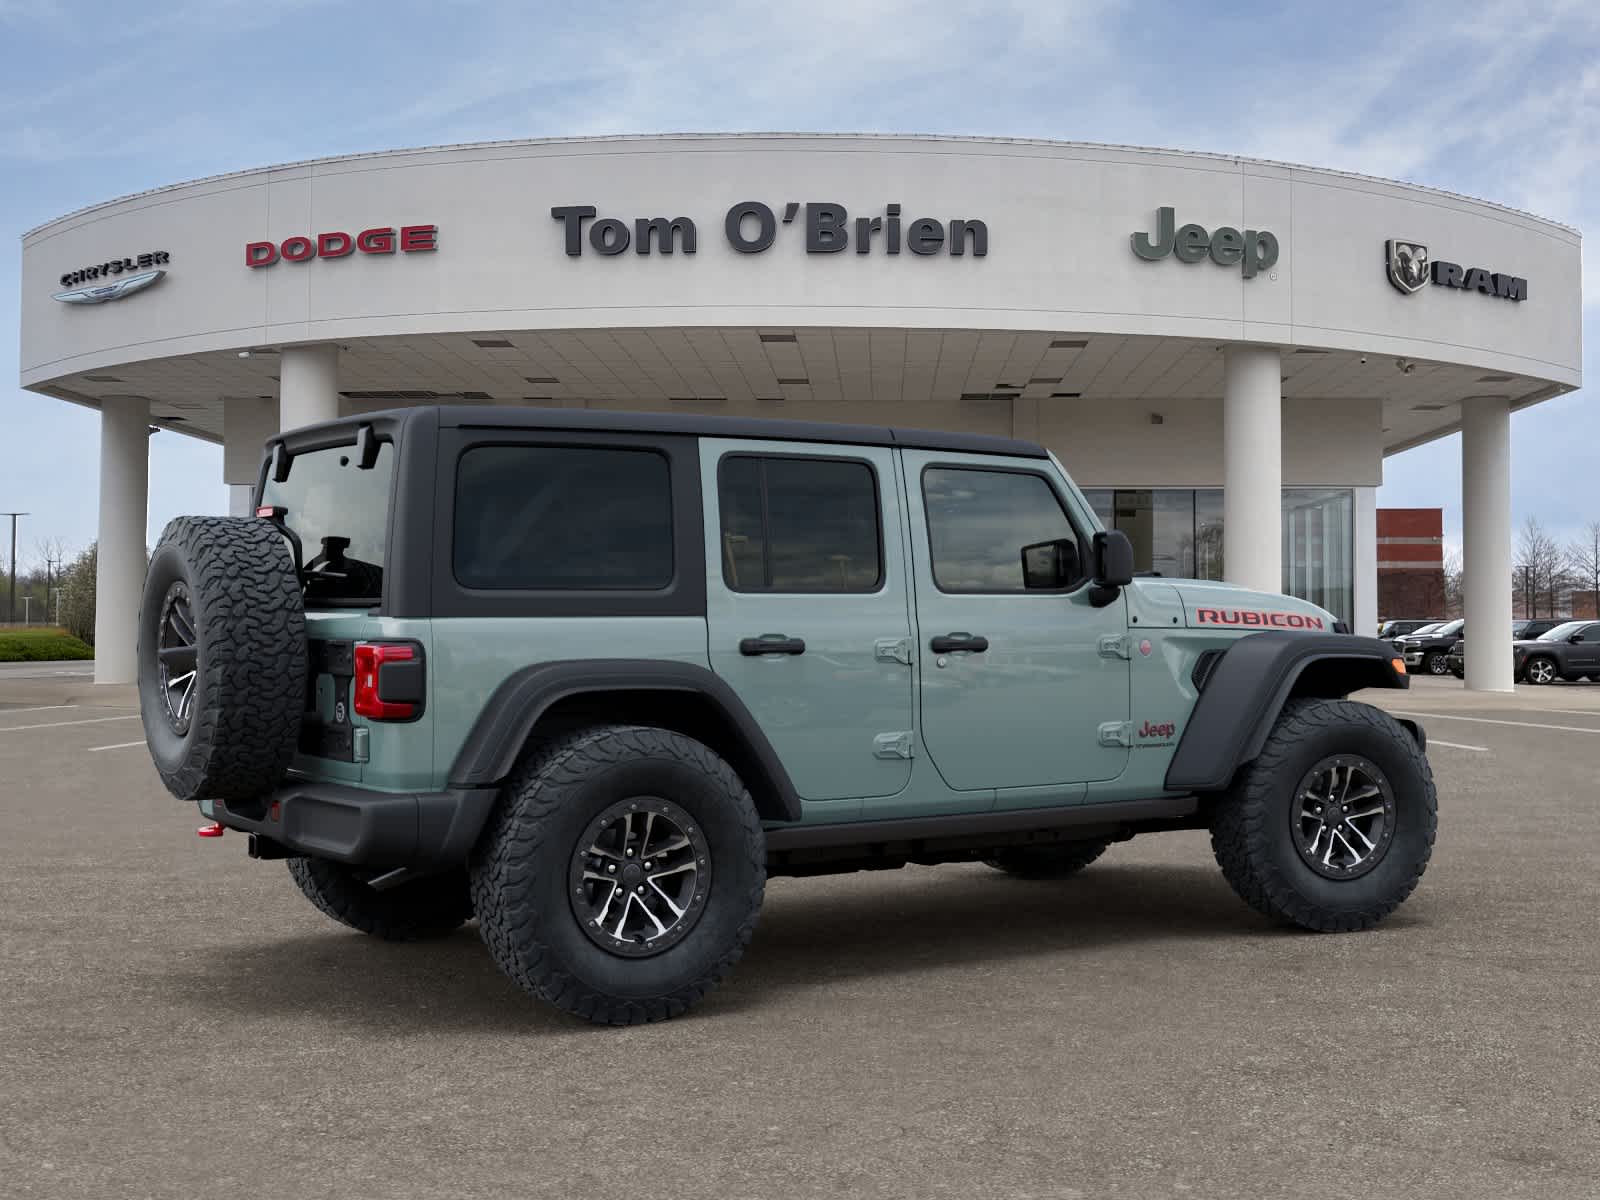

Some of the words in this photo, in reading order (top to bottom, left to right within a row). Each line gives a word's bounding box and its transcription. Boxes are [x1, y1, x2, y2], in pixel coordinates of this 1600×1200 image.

[246, 224, 438, 269] DODGE
[551, 205, 696, 257] Tom
[724, 201, 988, 257] O'Brien
[1130, 206, 1279, 279] Jeep
[60, 250, 170, 287] CHRYSLER
[1430, 261, 1527, 301] RAM
[1197, 608, 1324, 630] RUBICON
[1138, 719, 1176, 739] Jeep
